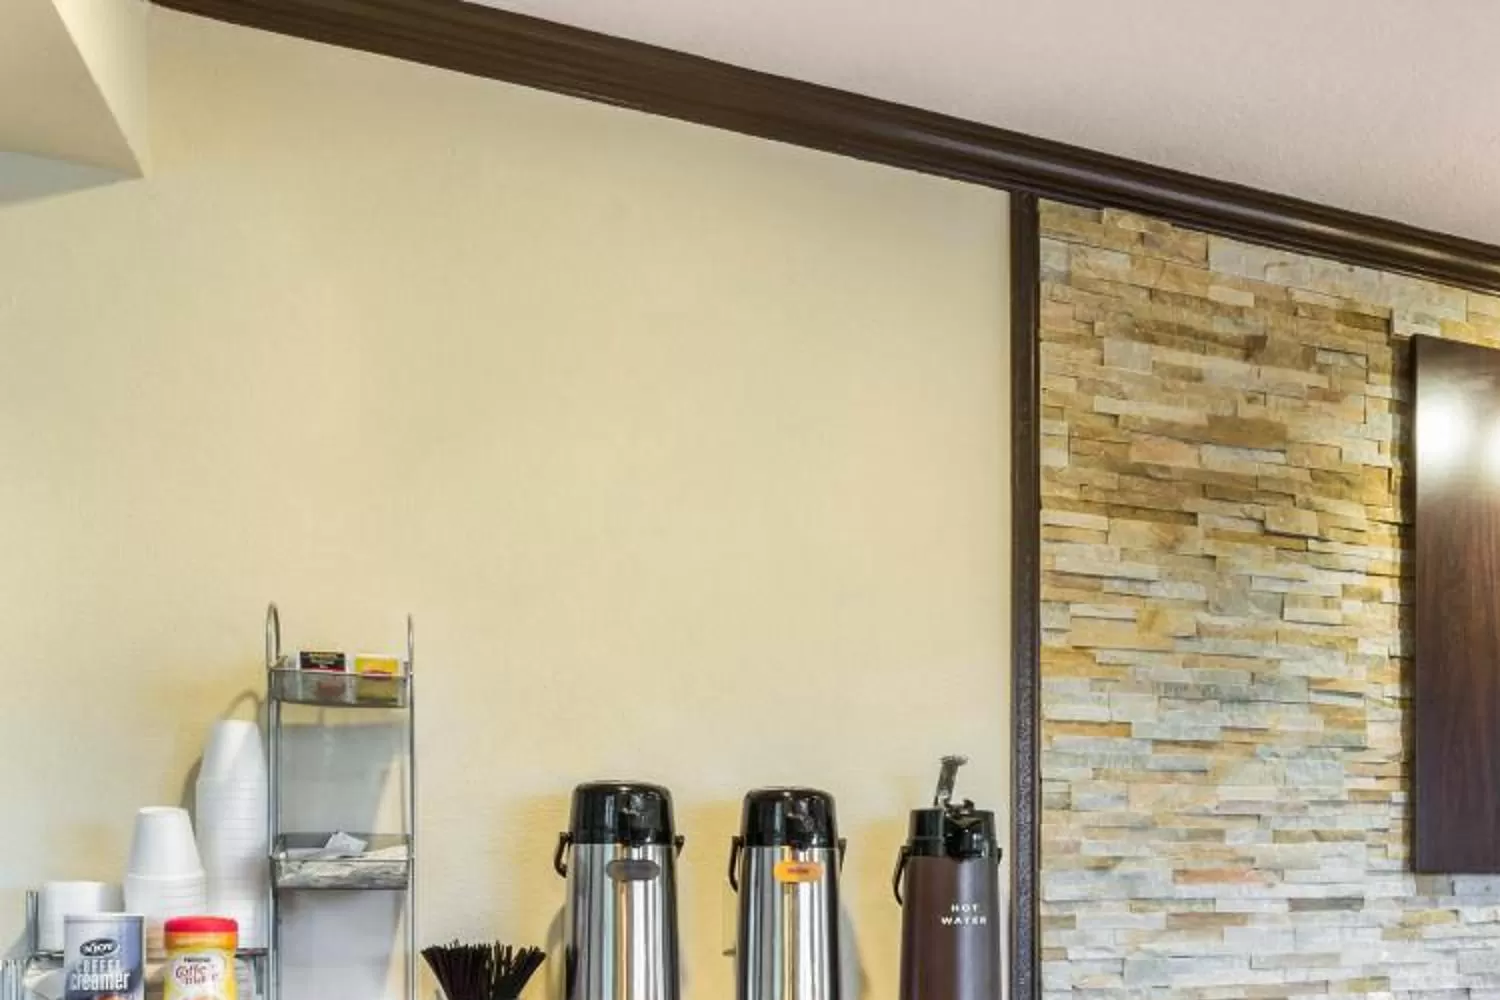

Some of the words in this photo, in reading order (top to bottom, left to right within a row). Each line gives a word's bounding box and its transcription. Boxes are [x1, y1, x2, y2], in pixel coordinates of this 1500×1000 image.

[951, 903, 979, 913] HOT
[941, 916, 987, 925] WATER
[71, 973, 131, 991] creamer
